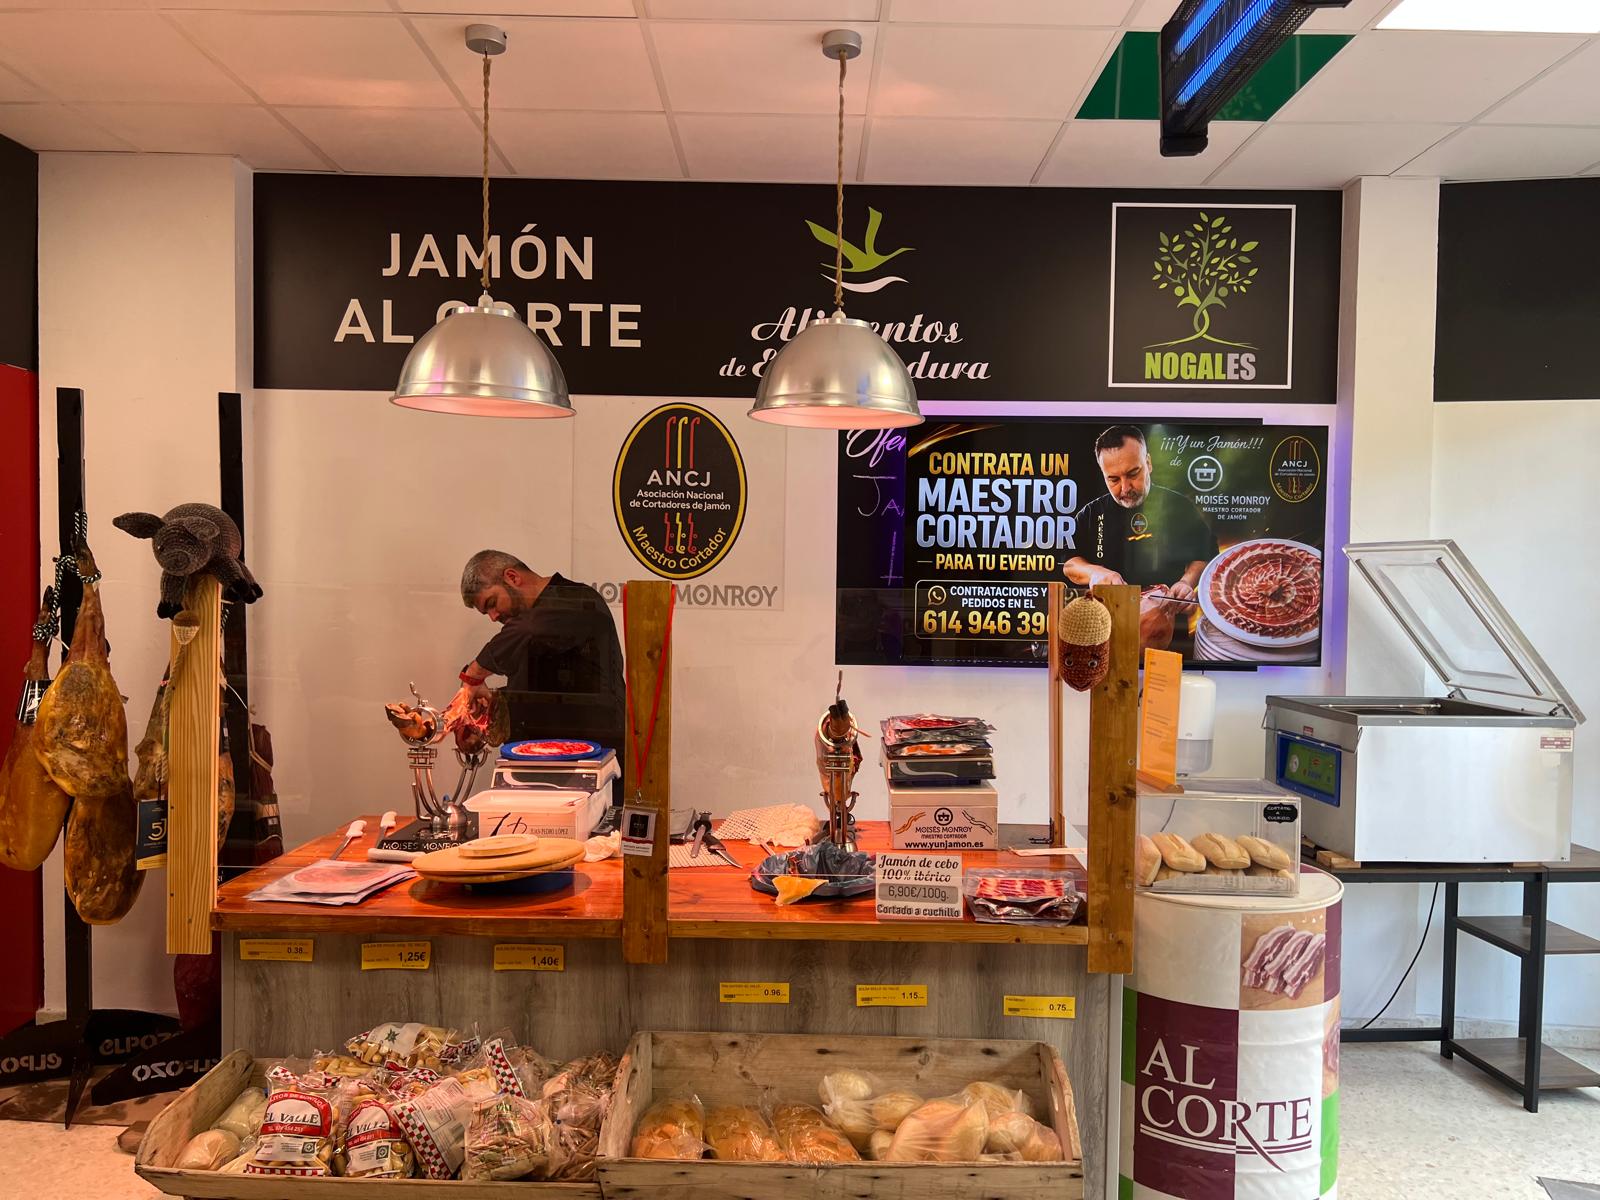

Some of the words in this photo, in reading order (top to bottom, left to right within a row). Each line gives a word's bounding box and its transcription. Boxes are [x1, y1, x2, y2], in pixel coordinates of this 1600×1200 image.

[382, 224, 593, 280] JAMÓN
[334, 299, 414, 343] AL
[436, 300, 641, 347] RTE
[719, 357, 746, 377] de
[1144, 352, 1256, 380] NOGALES
[929, 452, 1036, 476] CONTRATA
[1040, 453, 1069, 476] UN
[1170, 456, 1182, 466] de
[1282, 460, 1308, 468] ANCJ
[647, 470, 711, 487] ANCJ
[637, 489, 684, 499] Asociación
[687, 491, 724, 500] Nacional
[918, 477, 1077, 514] MAESTRO
[1195, 494, 1229, 505] MOISÉS
[1231, 496, 1270, 505] MONROY
[629, 500, 641, 508] de
[643, 500, 690, 509] Cortadores
[704, 502, 731, 511] Jamón
[916, 514, 1076, 550] CORTADOR
[633, 526, 677, 569] Maestro
[679, 528, 727, 570] Cortador
[936, 553, 974, 570] PARA
[977, 554, 995, 571] TU
[1000, 555, 1055, 571] EVENTO
[676, 584, 778, 607] MONROY
[950, 586, 1039, 597] CONTRATACIONES
[1041, 587, 1048, 597] Y
[961, 598, 1005, 608] PEDIDOS
[1008, 599, 1021, 608] EN
[1024, 599, 1036, 609] EL
[923, 610, 962, 634] 614
[968, 611, 1011, 635] 946
[1017, 611, 1049, 635] 39
[905, 840, 984, 849] www.yunjamon.es
[879, 855, 916, 869] Jamón
[919, 857, 933, 868] de
[935, 859, 959, 869] cebo
[882, 869, 911, 880] 100%
[914, 870, 951, 882] ibérico
[888, 886, 949, 901] 6,90€/100g.
[877, 904, 912, 915] Cortado
[922, 907, 959, 917] cuchillo
[399, 952, 426, 963] 1,25€
[531, 956, 559, 966] 1,40€
[1141, 1038, 1216, 1090] AL
[280, 1113, 319, 1124] VALLE
[1140, 1085, 1313, 1173] CORTE
